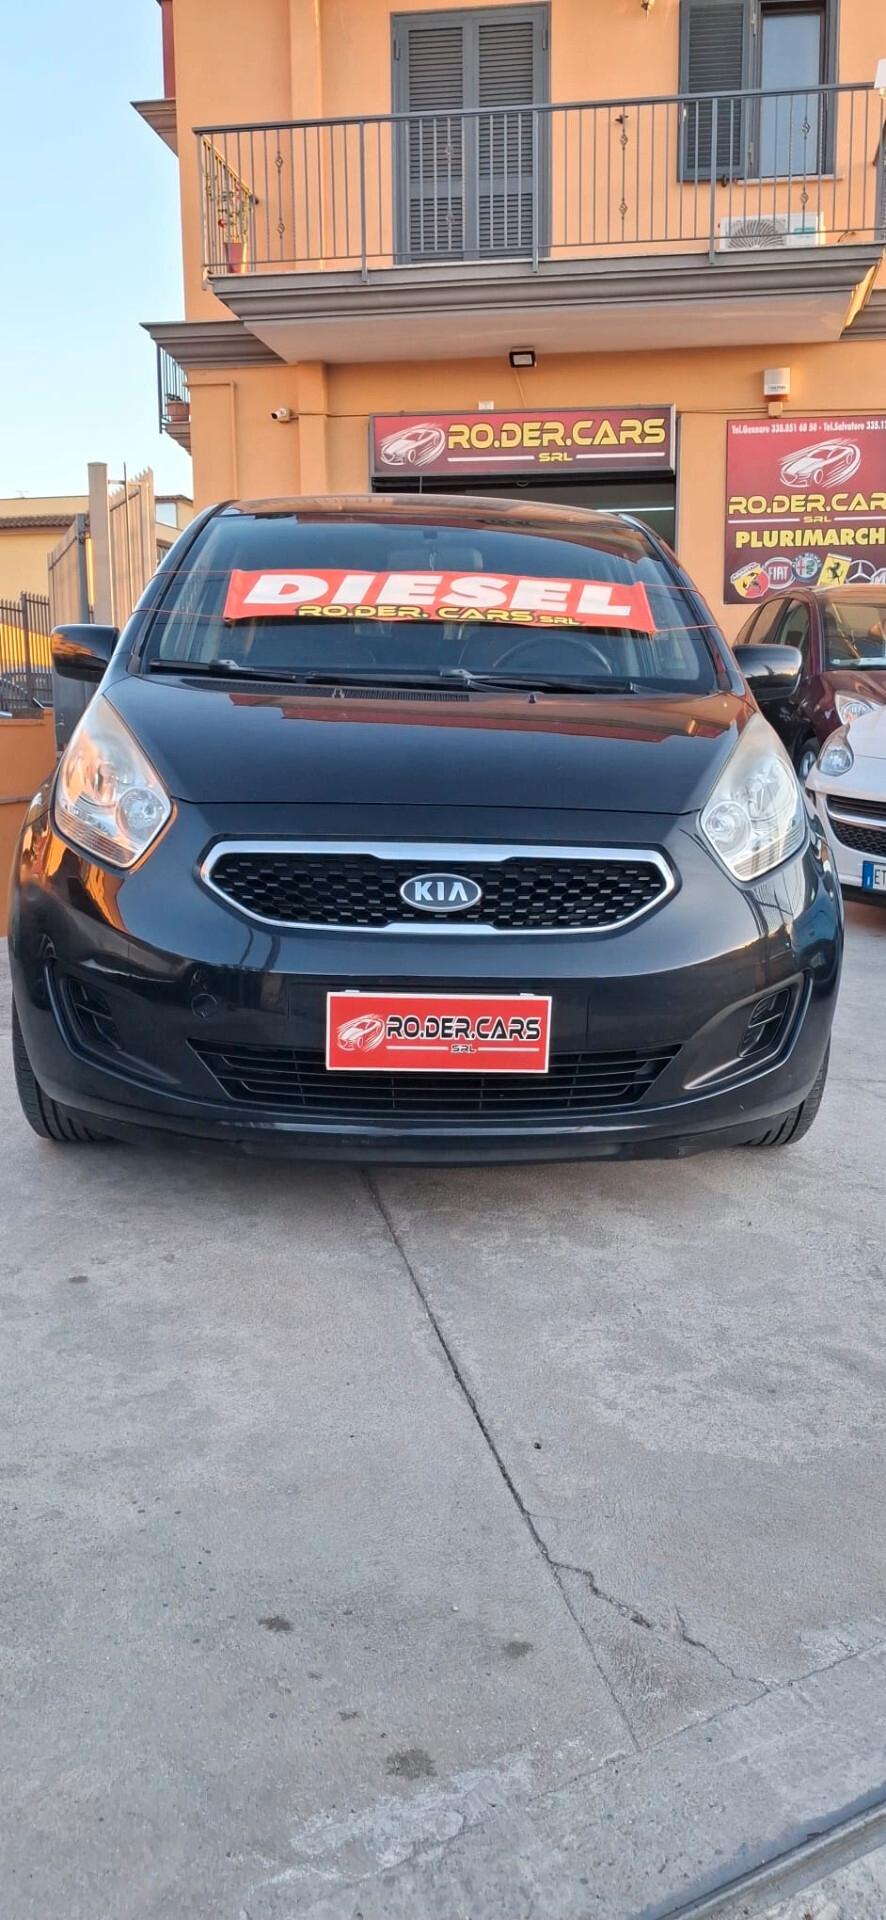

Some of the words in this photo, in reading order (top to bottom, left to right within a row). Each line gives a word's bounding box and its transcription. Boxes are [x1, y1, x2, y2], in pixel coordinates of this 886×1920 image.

[448, 418, 665, 449] RO.DER.CARS
[538, 452, 573, 462] SRL
[803, 515, 832, 523] SRL
[735, 527, 886, 548] PLURIMARCH
[768, 565, 789, 581] FIAT
[243, 574, 631, 616] DIESEL
[437, 606, 534, 622] CARS
[540, 615, 580, 625] SRL
[414, 881, 468, 901] KIA
[386, 1015, 541, 1041] RO.DER.CARS
[451, 1044, 476, 1053] SRL
